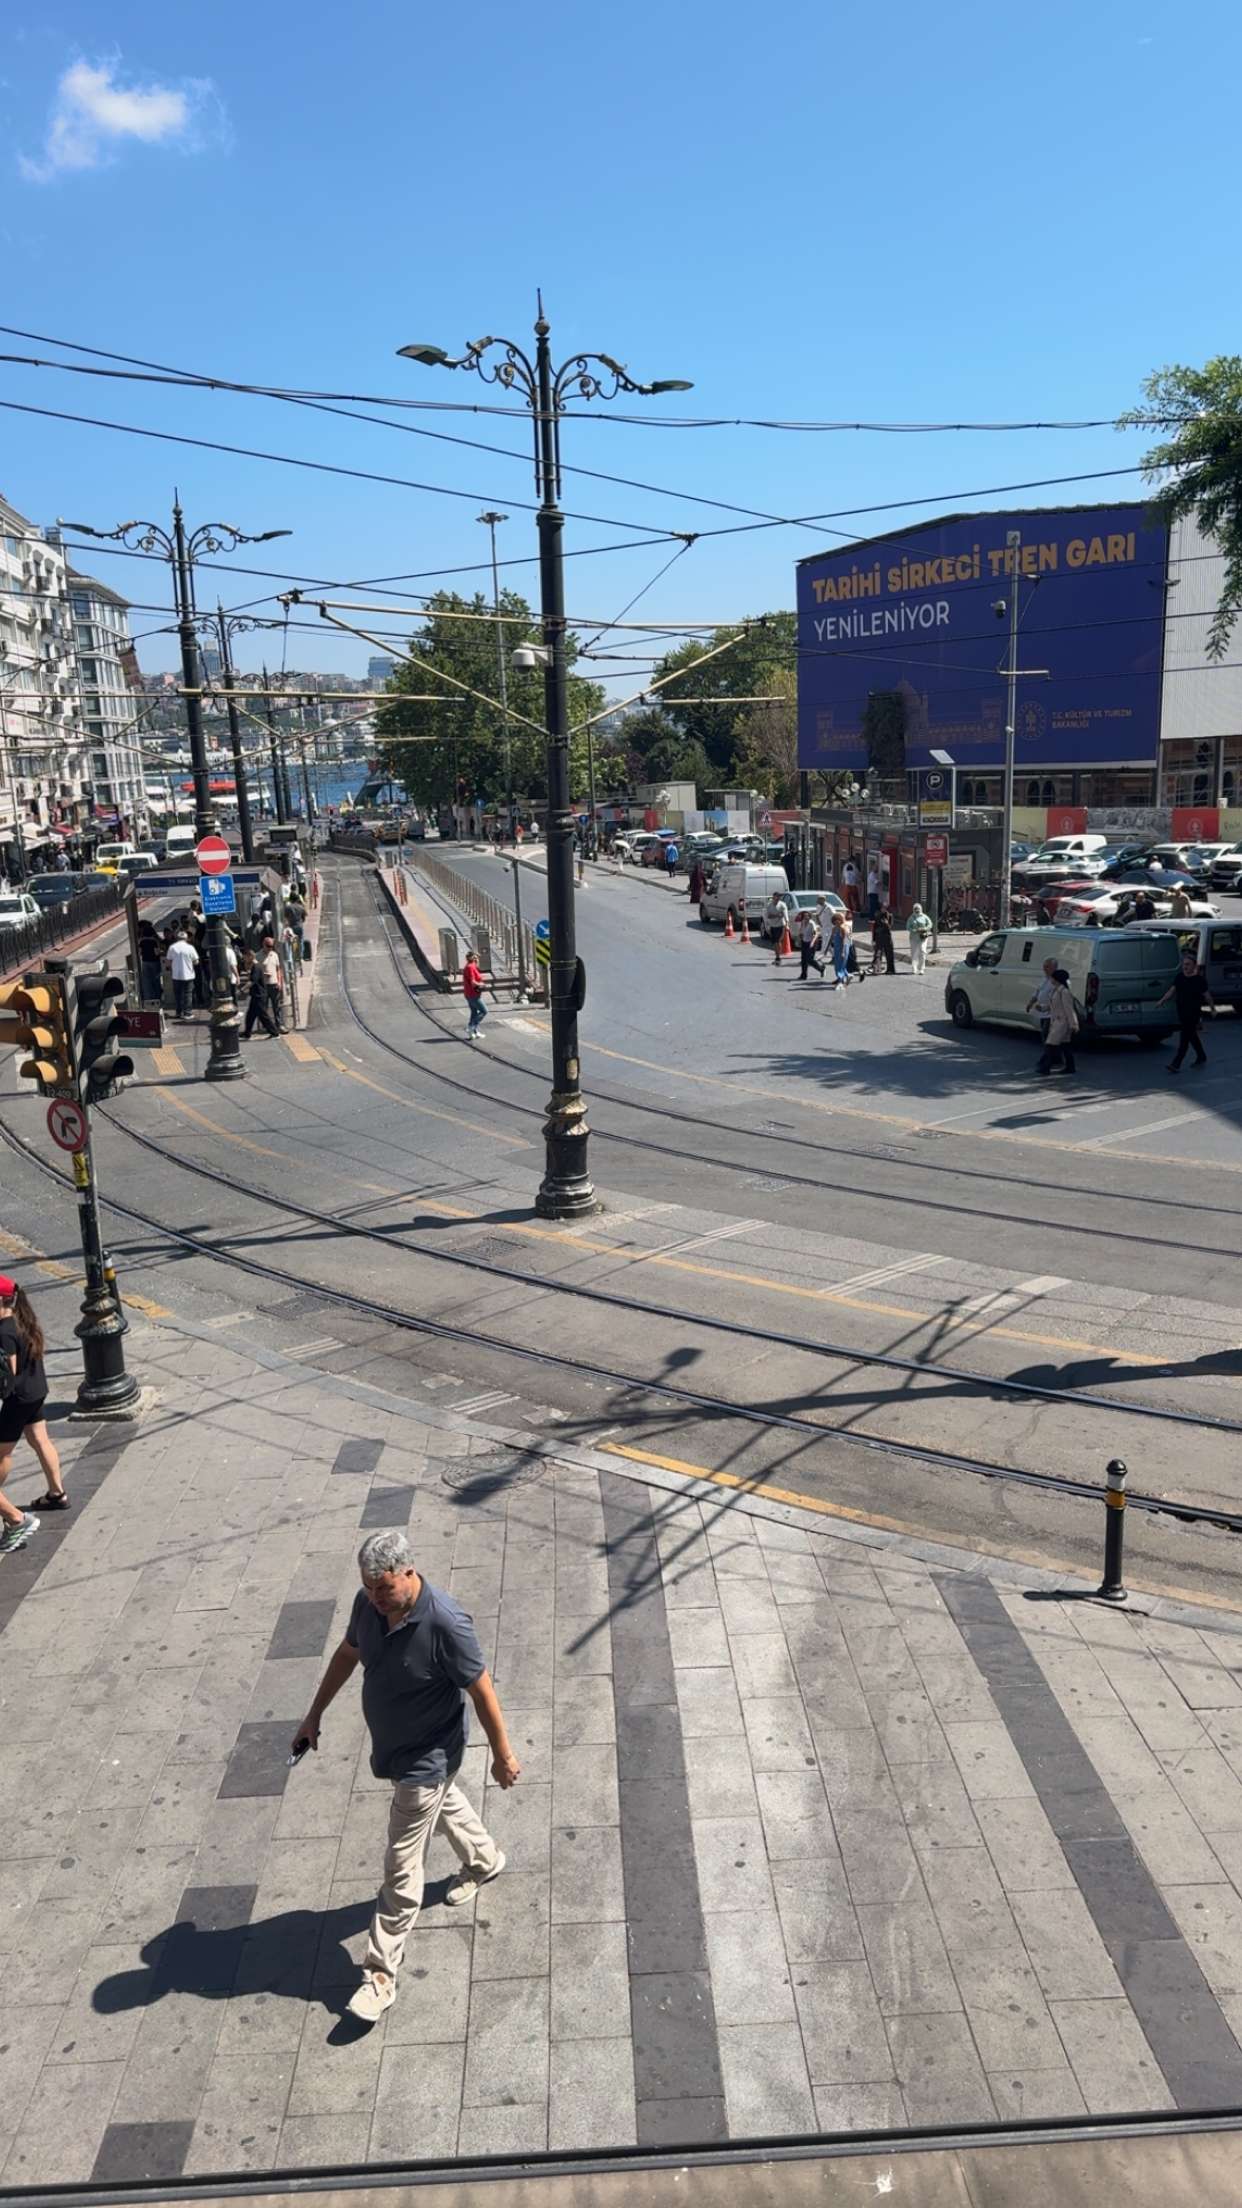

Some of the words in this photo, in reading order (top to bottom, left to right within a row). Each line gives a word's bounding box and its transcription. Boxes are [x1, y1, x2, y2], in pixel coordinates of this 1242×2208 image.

[812, 562, 881, 604] TARİHİ
[887, 544, 980, 593] SİRKECİ
[987, 543, 1059, 577] TREN
[1066, 532, 1136, 568] GARI
[813, 601, 950, 642] YENİLENİYOR
[929, 775, 941, 785] P
